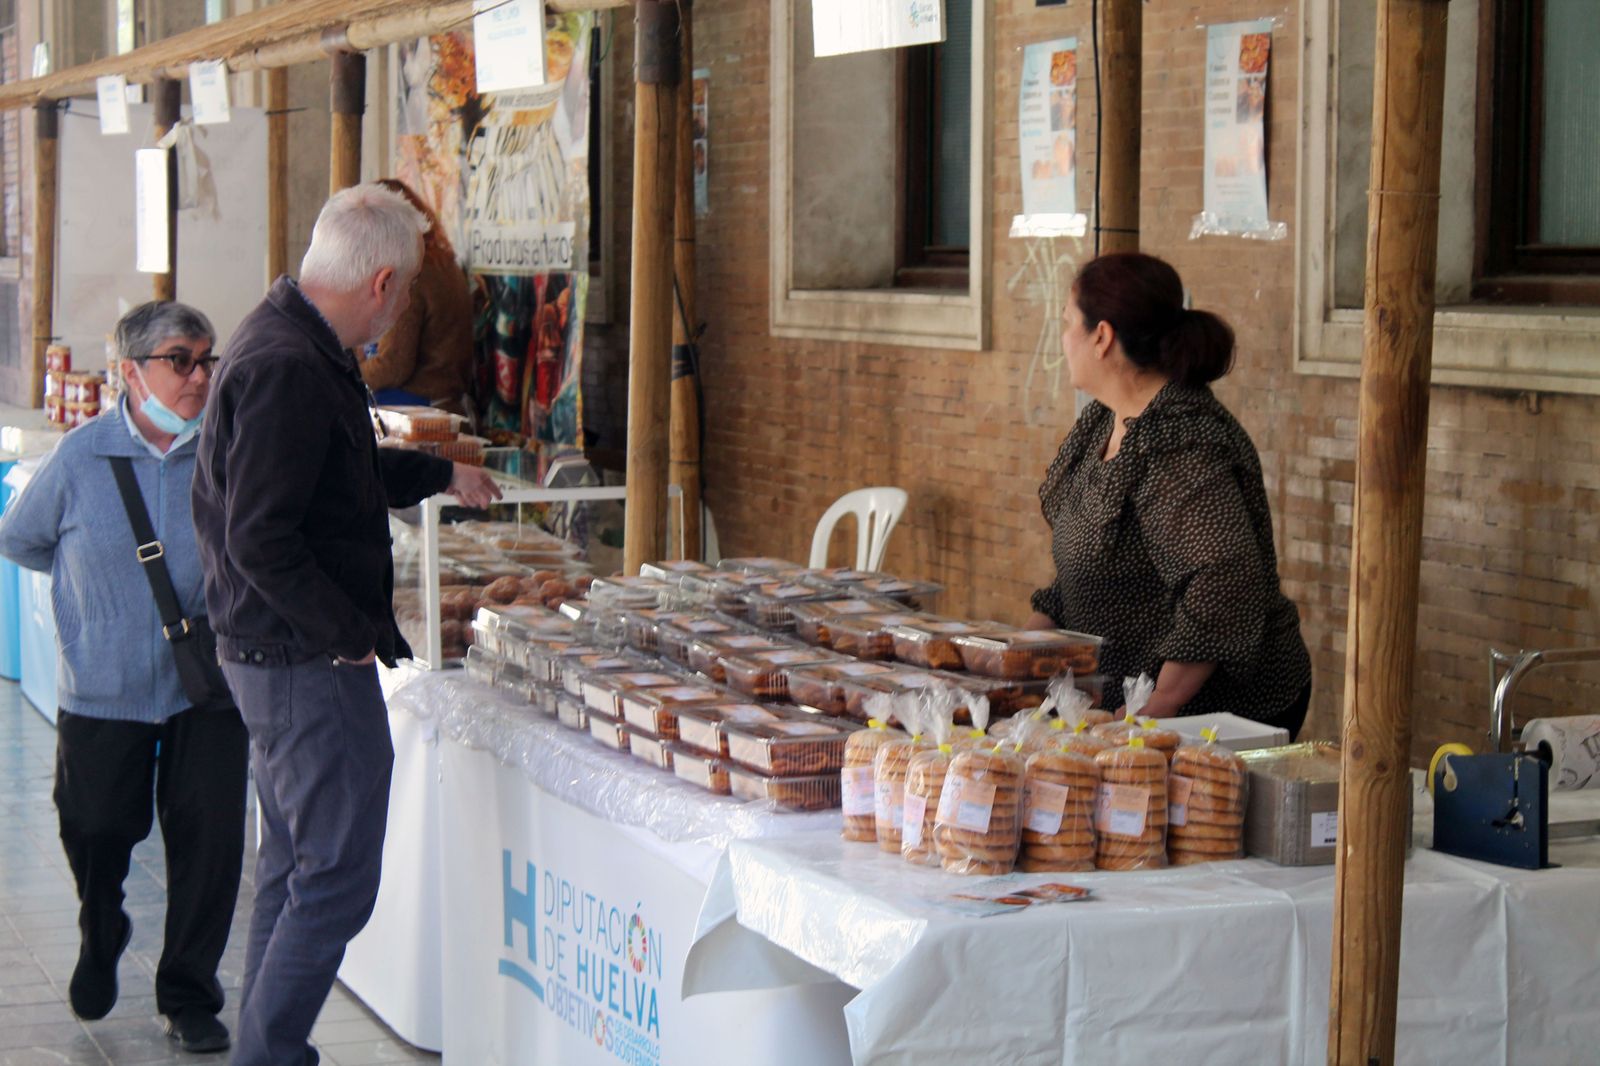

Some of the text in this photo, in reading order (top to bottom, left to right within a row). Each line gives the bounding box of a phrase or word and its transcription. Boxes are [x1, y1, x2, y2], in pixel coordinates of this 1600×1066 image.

[544, 869, 662, 981] DIPUTACIÓN
[544, 925, 660, 1039] DE HUELVA
[546, 978, 614, 1052] OBJETIVOS
